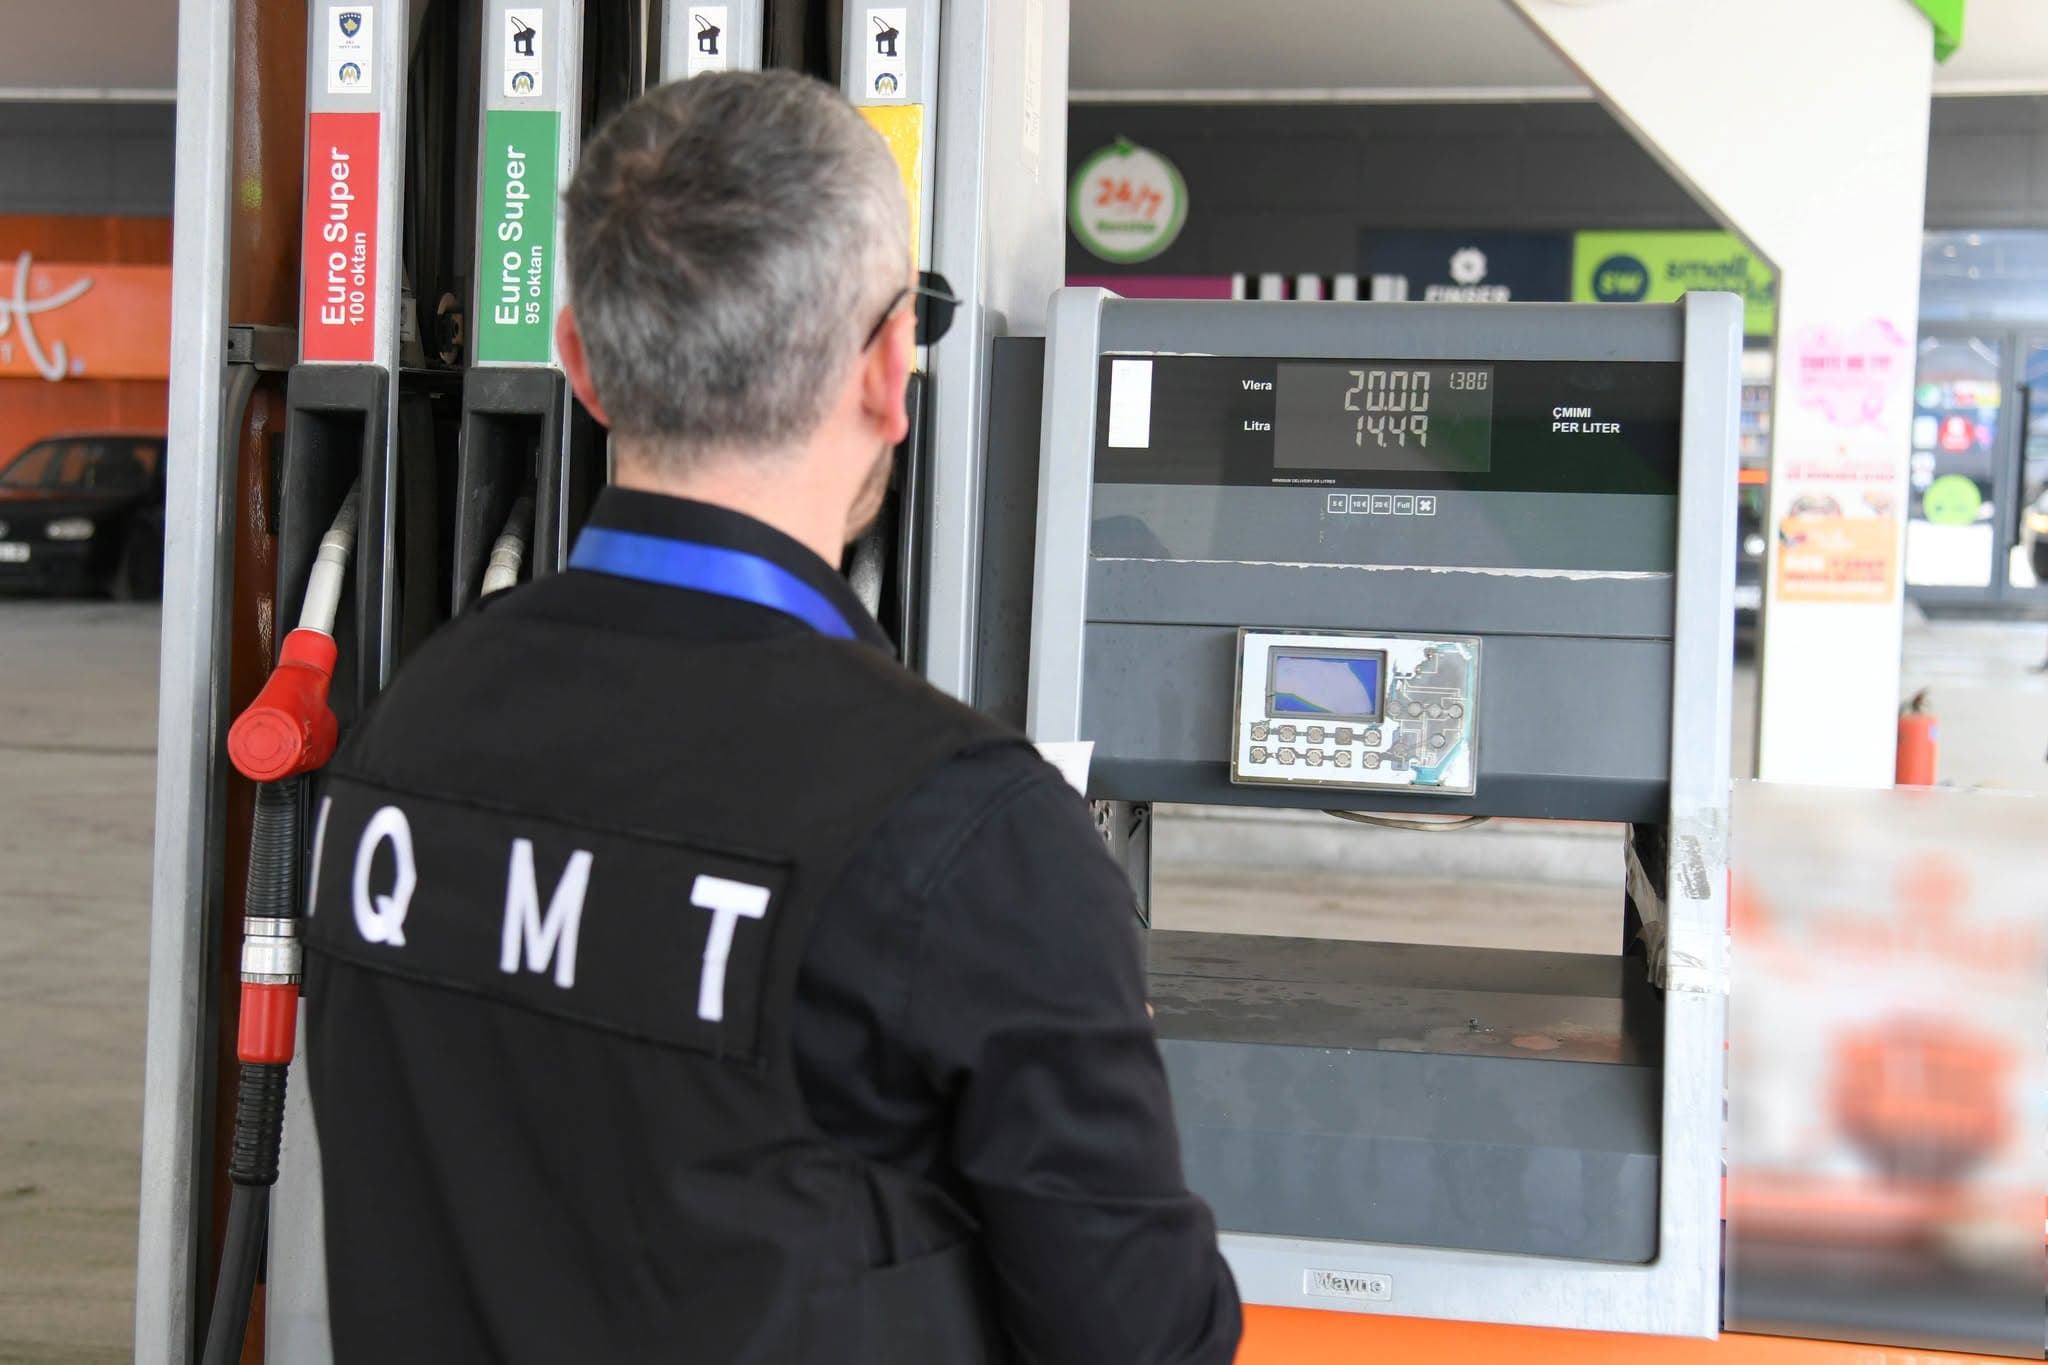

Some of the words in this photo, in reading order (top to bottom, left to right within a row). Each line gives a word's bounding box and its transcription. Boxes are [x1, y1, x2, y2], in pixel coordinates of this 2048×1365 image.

[323, 147, 355, 243] Super
[498, 145, 530, 242] Super
[351, 232, 367, 286] oktan
[527, 245, 542, 297] oktan
[322, 252, 347, 326] Euro
[350, 291, 365, 326] 100
[495, 251, 522, 325] Euro
[525, 302, 541, 324] 95
[1242, 380, 1272, 391] Vlera
[1344, 370, 1430, 412] 20.00
[1552, 407, 1591, 420] ÇMIMI
[1244, 421, 1271, 431] Litra
[1356, 415, 1428, 448] 14.49
[1552, 422, 1579, 433] PER
[1582, 422, 1620, 434] LITER
